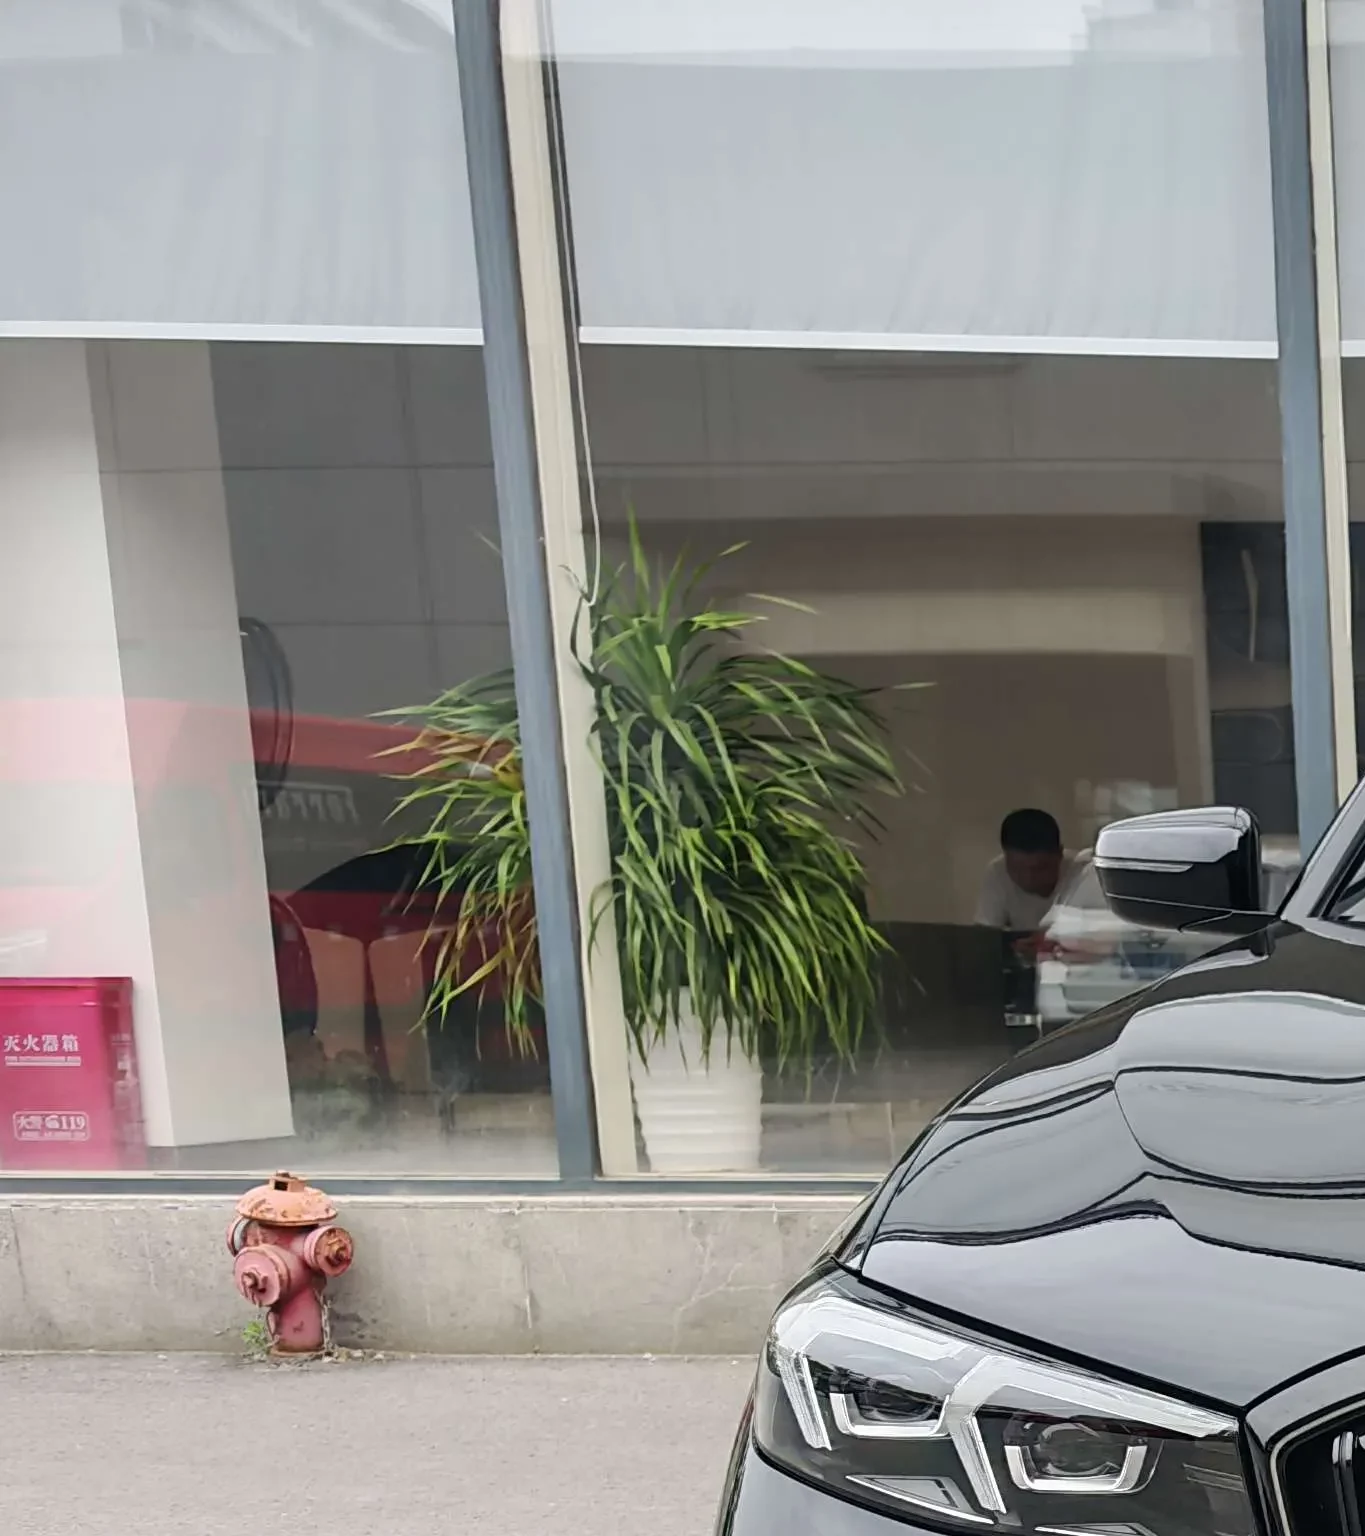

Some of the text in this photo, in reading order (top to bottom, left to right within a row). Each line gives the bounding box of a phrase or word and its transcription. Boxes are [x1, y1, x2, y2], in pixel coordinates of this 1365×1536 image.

[3, 1034, 80, 1052] 灭火器箱
[60, 1115, 86, 1130] 119
